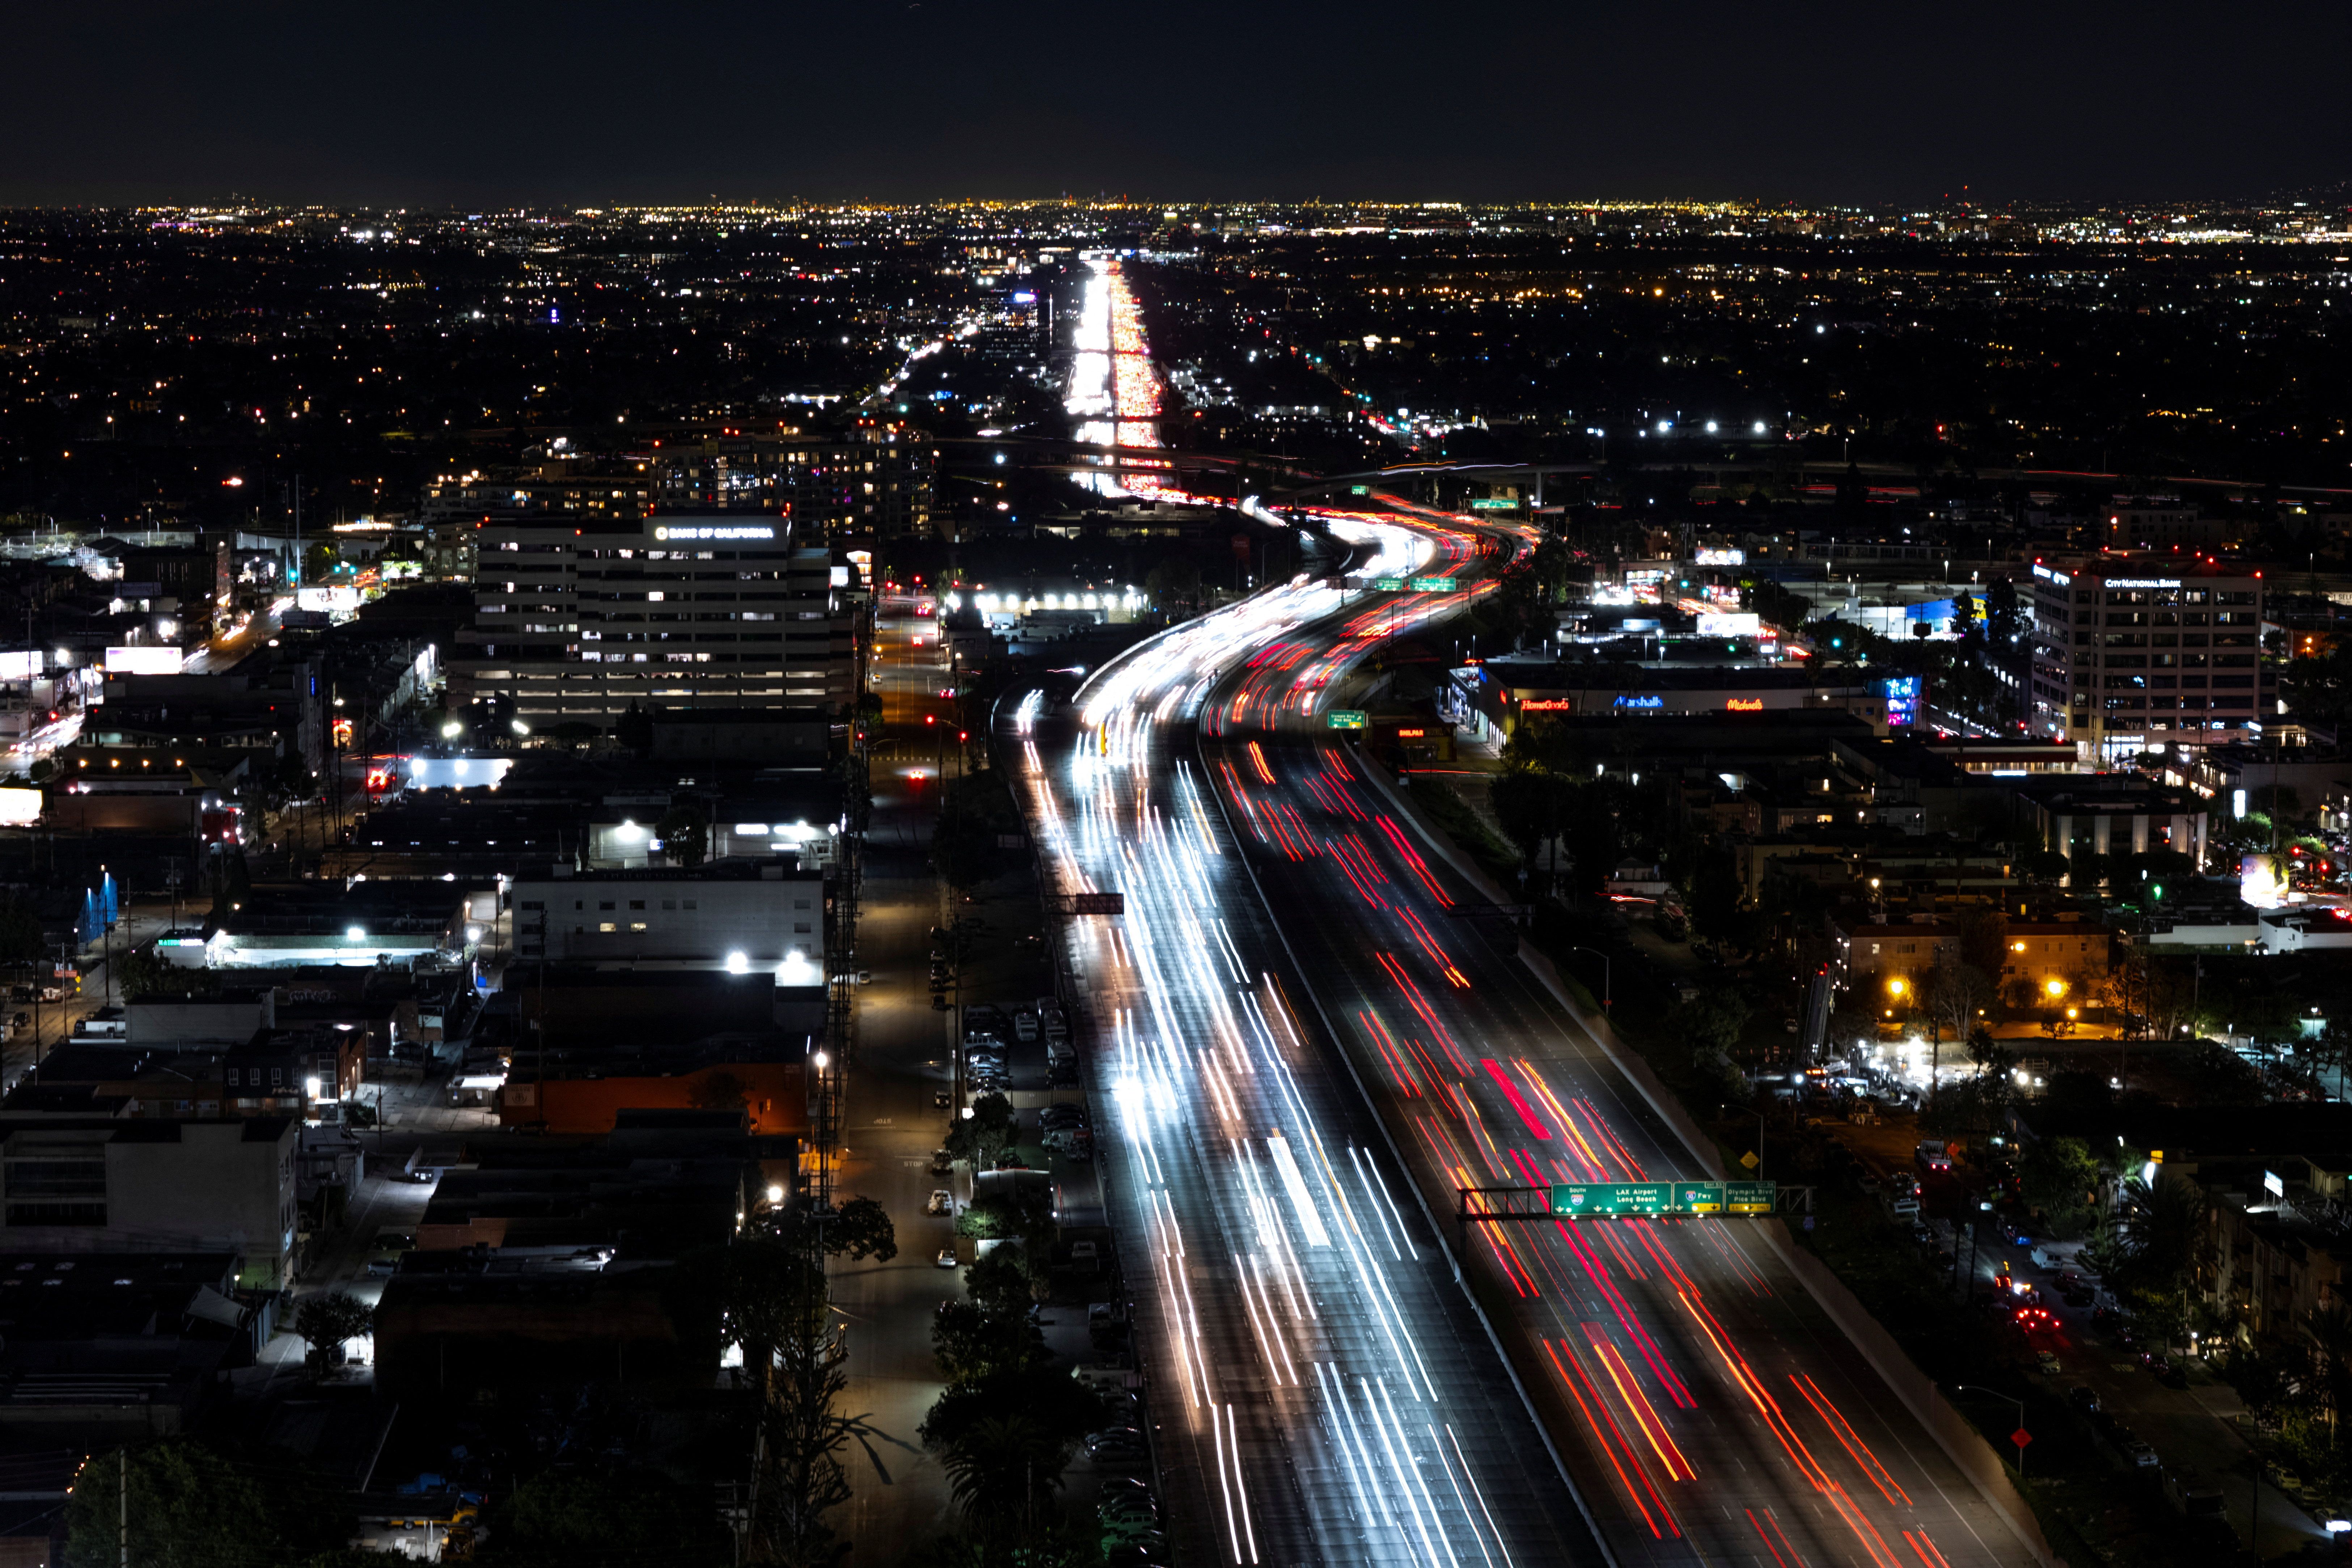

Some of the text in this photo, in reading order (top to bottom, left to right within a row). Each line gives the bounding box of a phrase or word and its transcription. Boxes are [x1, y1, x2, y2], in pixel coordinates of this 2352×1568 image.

[669, 528, 773, 538] BANK OF CALIFORNIA
[1522, 700, 1568, 710] HomeGoods
[1613, 696, 1663, 707] Marshalls
[1727, 698, 1763, 710] Michaels
